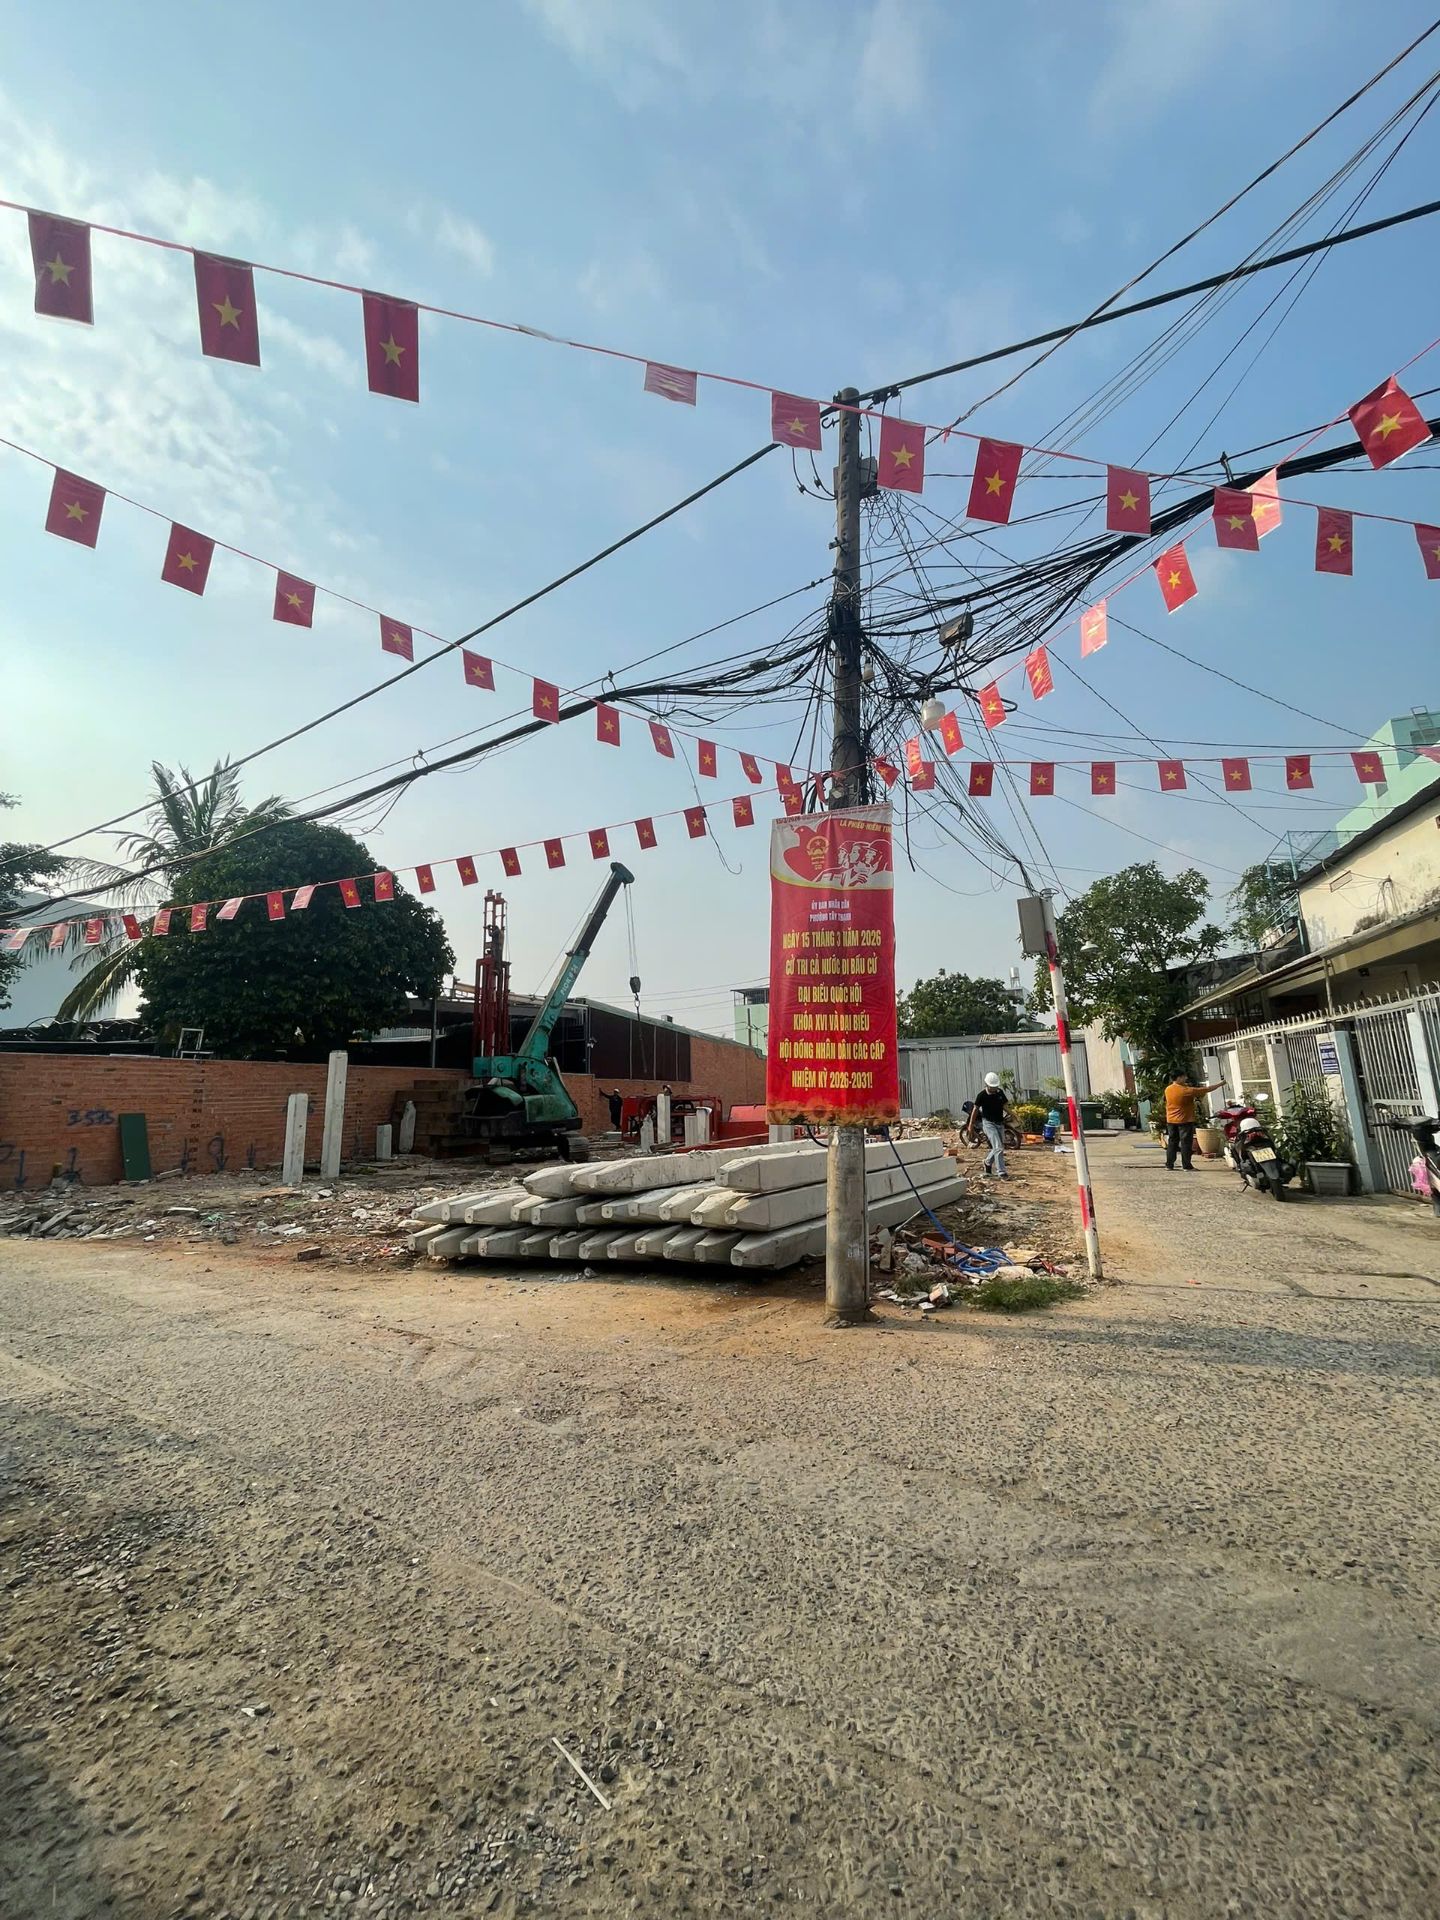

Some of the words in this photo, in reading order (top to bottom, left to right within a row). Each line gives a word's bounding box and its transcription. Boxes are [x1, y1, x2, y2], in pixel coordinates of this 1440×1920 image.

[783, 929, 800, 949] NGÀY
[801, 933, 810, 949] 15
[812, 928, 834, 948] THÁNG
[836, 932, 841, 947] 3
[842, 927, 859, 947] NĂM
[861, 930, 881, 947] 2026
[785, 953, 795, 975] CỬ
[796, 958, 808, 975] TRI
[810, 953, 820, 975] CẢ
[821, 954, 840, 975] NƯỚC
[867, 952, 878, 975] CỬ
[798, 986, 810, 1006] ĐẠI
[812, 982, 829, 1003] BIỂU
[830, 983, 849, 1004] QUỐC
[849, 982, 862, 1006] HỘI
[793, 1010, 813, 1031] KHÓA
[815, 1014, 828, 1031] XVI
[829, 1010, 839, 1031] VÀ
[839, 1014, 852, 1035] ĐẠI
[853, 1010, 870, 1031] BIỂU
[779, 1037, 792, 1062] HỘI
[815, 1038, 836, 1059] NHÂN
[837, 1038, 851, 1060] DÂN
[853, 1039, 868, 1060] CÁC
[870, 1039, 885, 1060] CẤP
[792, 1066, 816, 1091] NHIỆM
[818, 1067, 828, 1088] KỲ
[829, 1071, 873, 1089] 2026-2031!
